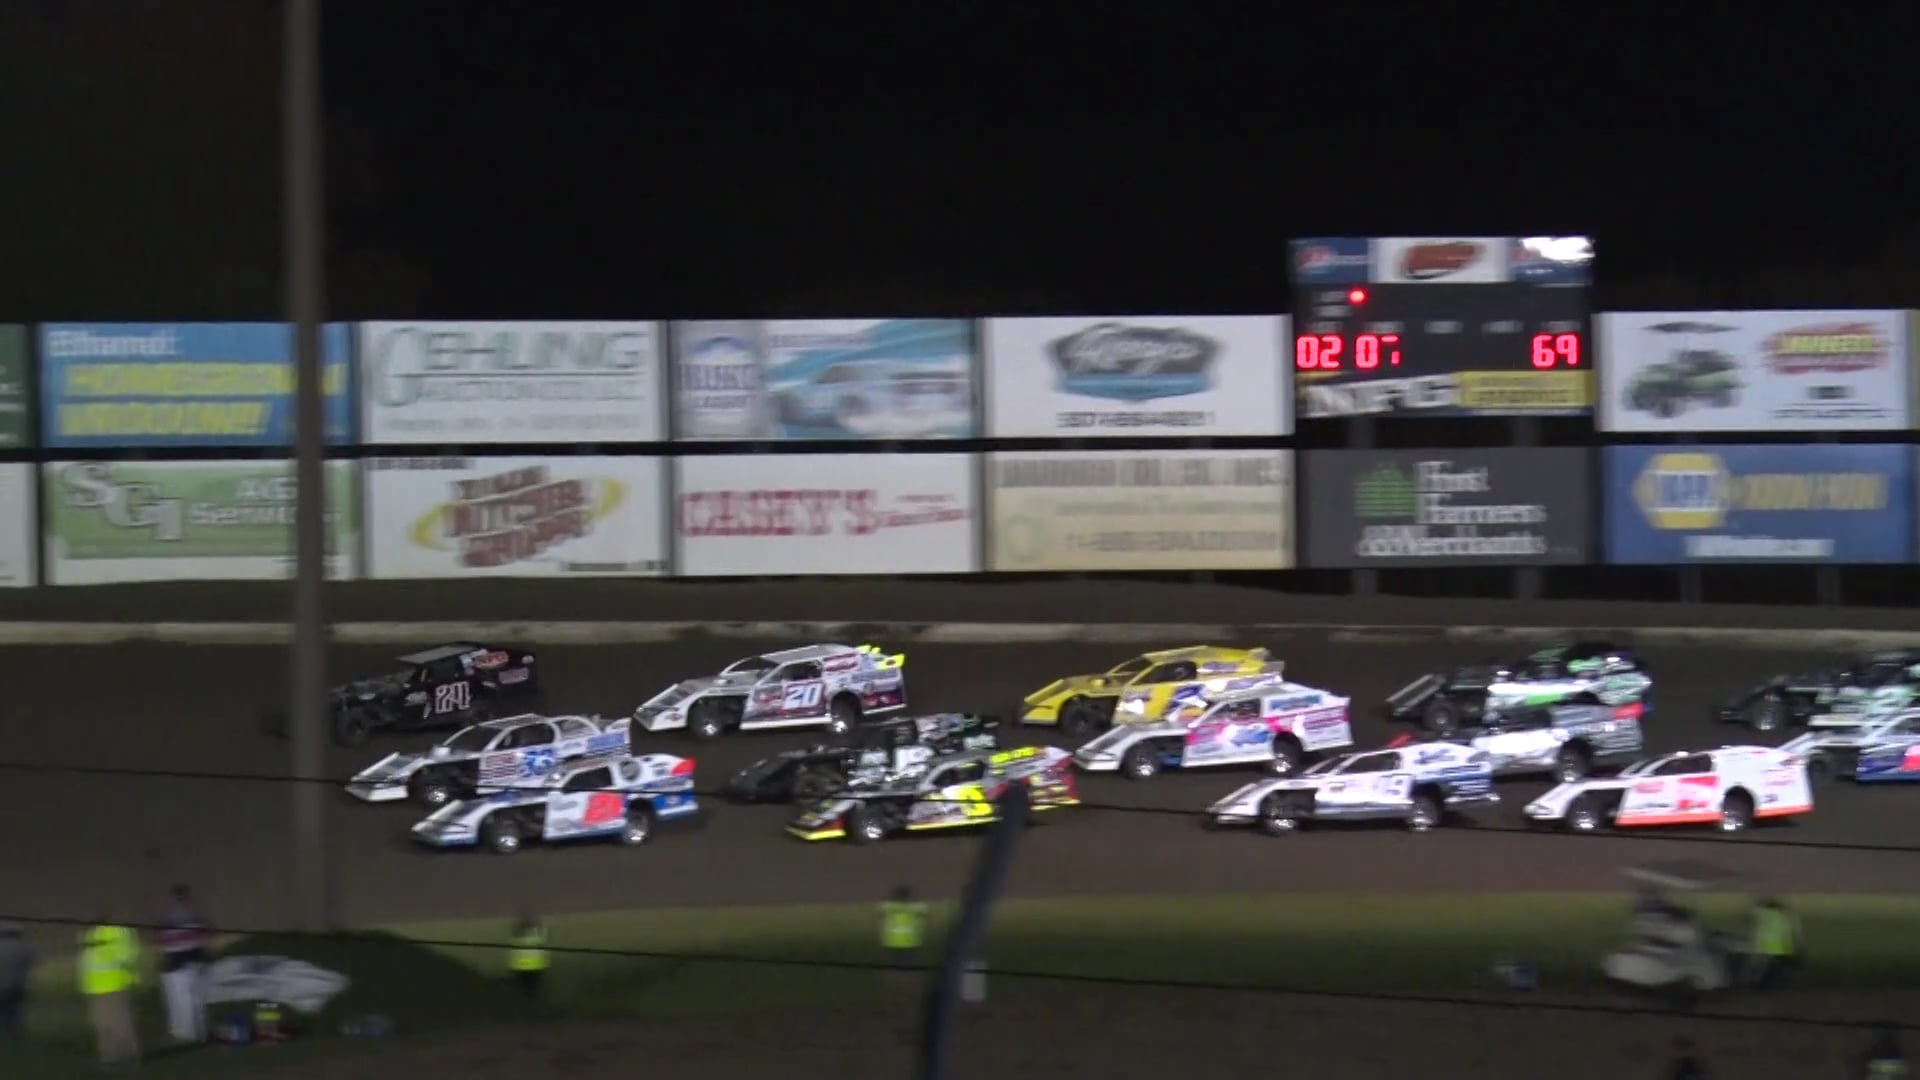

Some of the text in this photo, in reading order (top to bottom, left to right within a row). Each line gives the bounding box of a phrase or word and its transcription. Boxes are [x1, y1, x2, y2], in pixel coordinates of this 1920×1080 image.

[1296, 334, 1343, 369] 02
[1532, 334, 1579, 369] 69
[784, 683, 823, 709] 20
